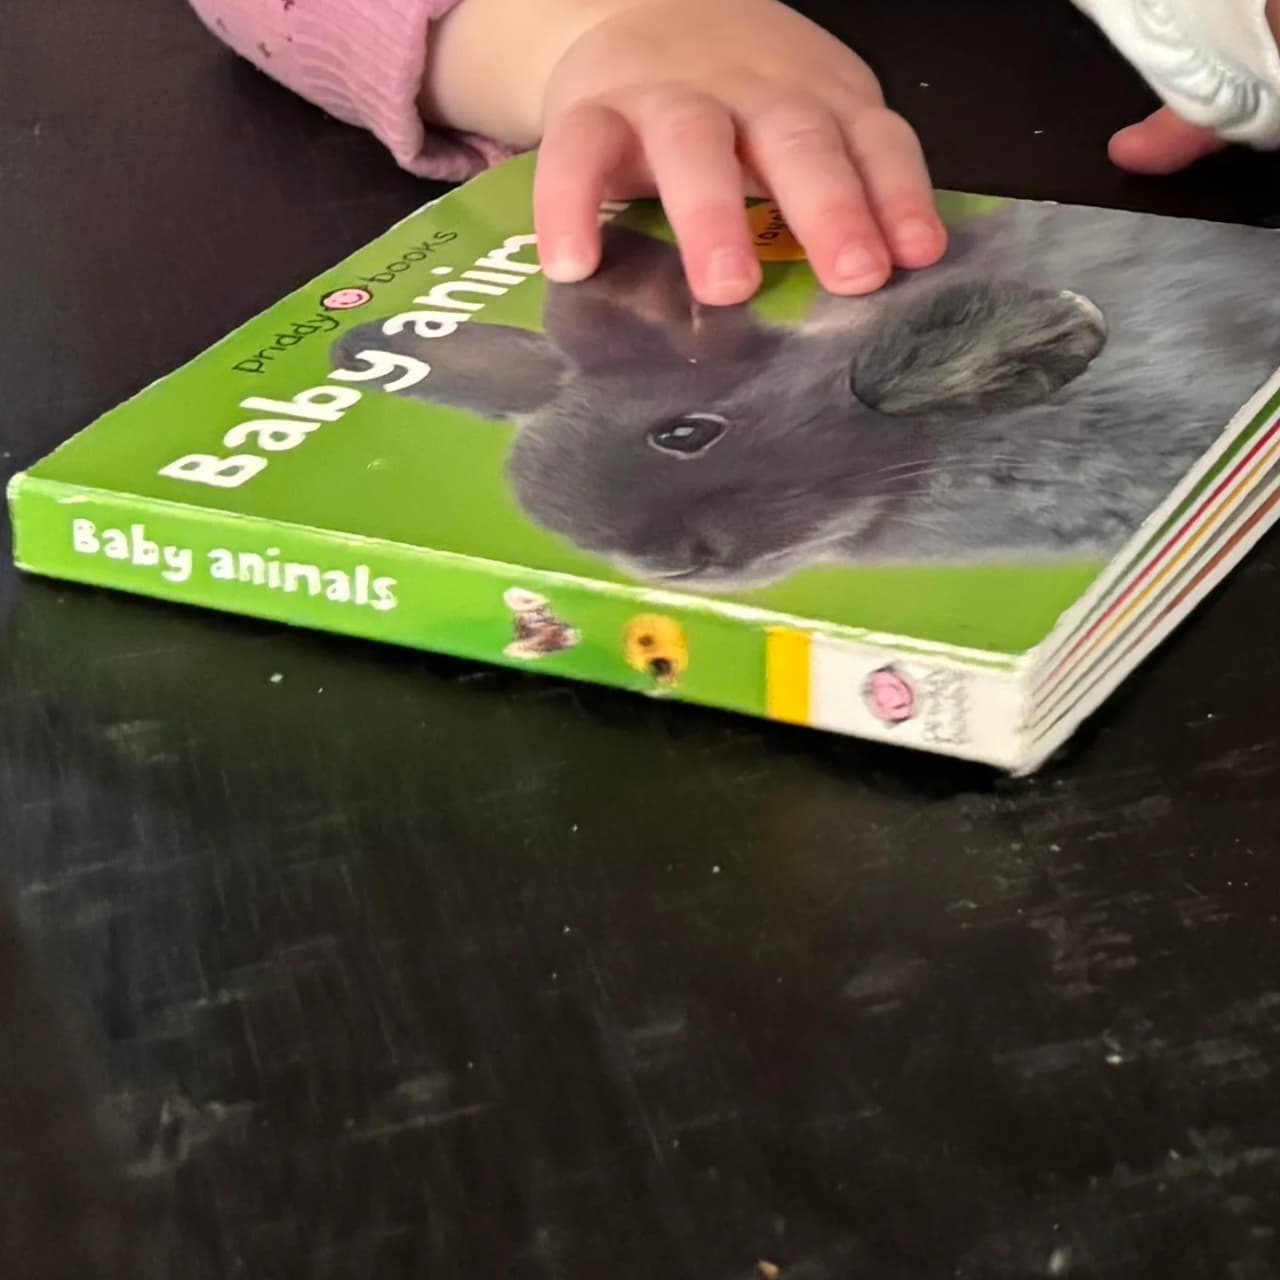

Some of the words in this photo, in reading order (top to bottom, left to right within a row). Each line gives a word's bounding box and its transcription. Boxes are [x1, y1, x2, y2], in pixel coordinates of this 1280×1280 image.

[231, 312, 340, 374] priddy
[357, 230, 458, 284] books
[156, 349, 432, 488] Baby
[72, 517, 193, 583] Baby
[206, 546, 399, 611] animals
